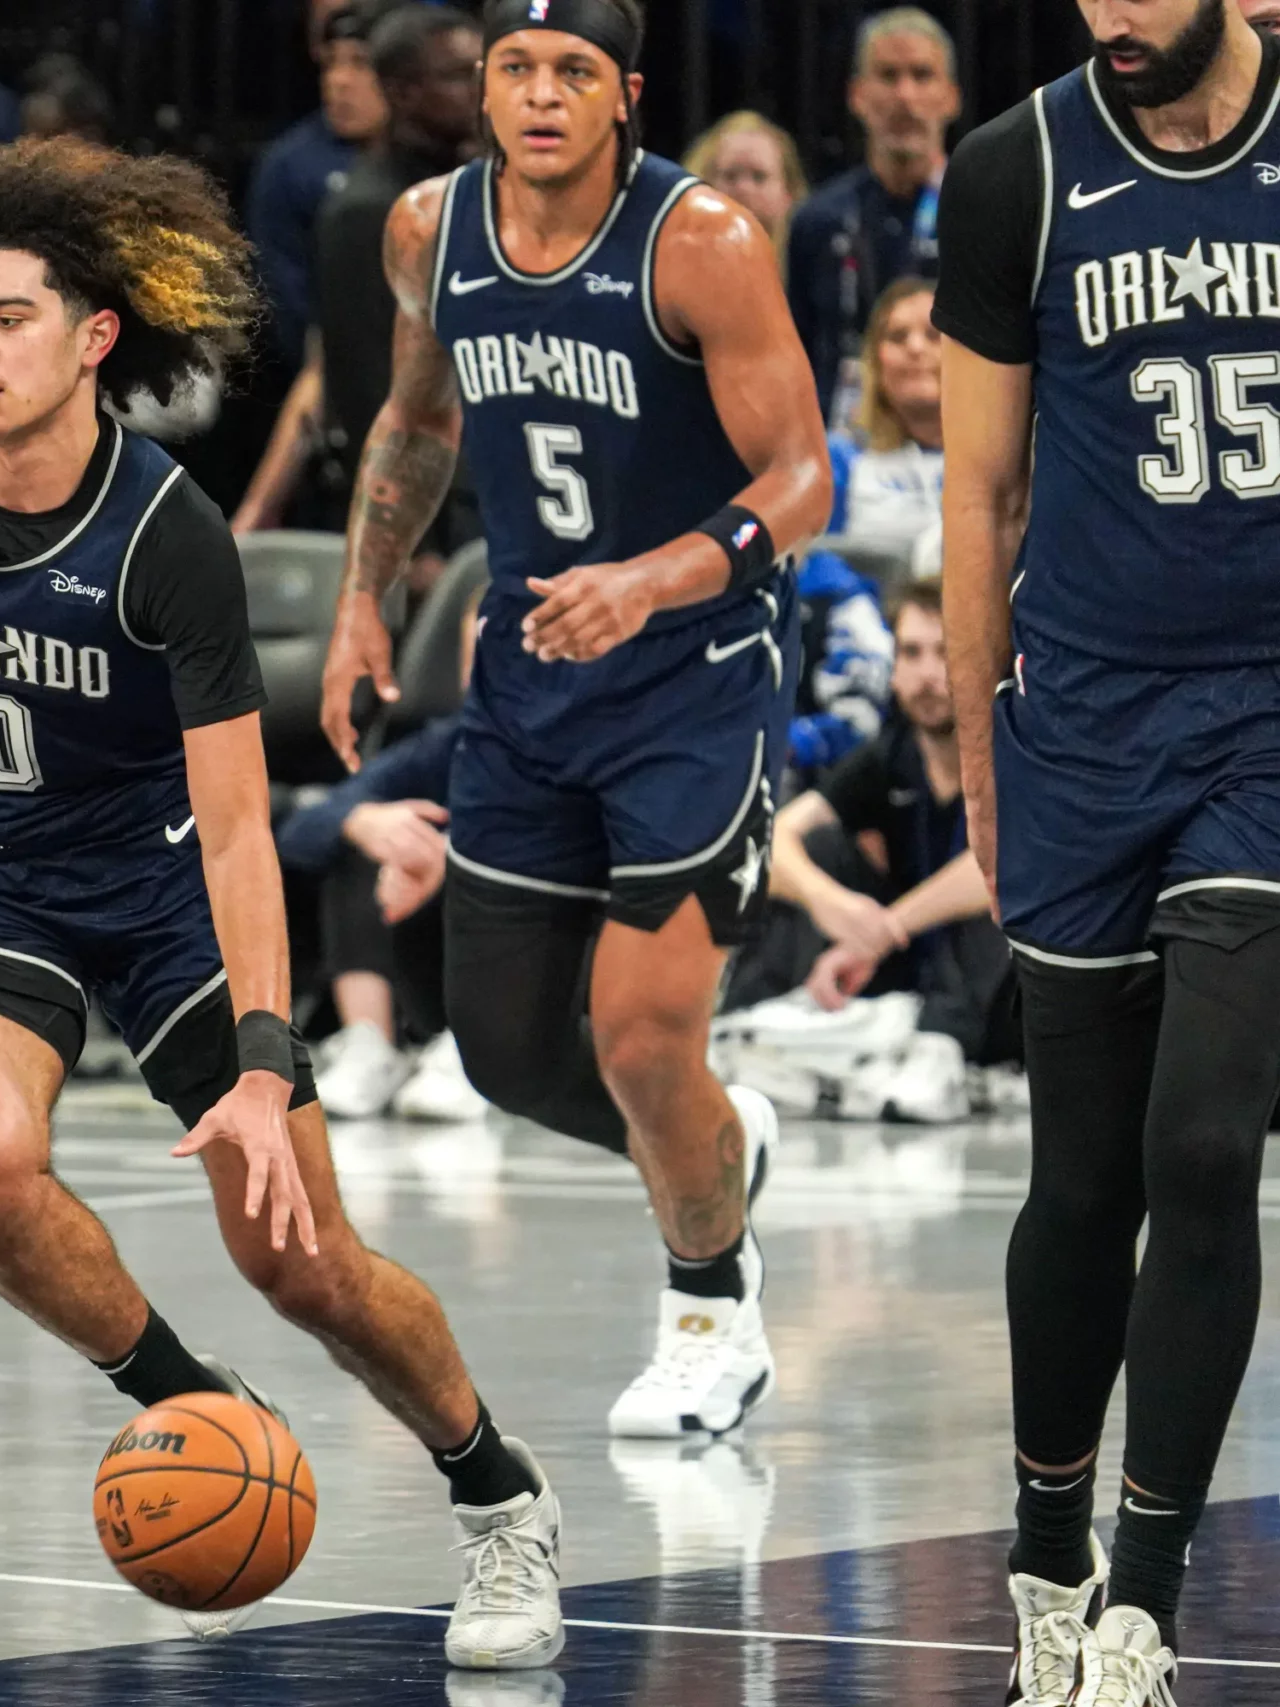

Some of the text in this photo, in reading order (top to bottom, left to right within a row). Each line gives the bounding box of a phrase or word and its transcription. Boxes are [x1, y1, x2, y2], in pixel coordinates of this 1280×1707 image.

[1074, 237, 1280, 348] ORLND
[452, 330, 640, 419] ORLNDO
[1130, 351, 1280, 503] 35
[523, 421, 594, 541] 5
[47, 569, 107, 604] Disney
